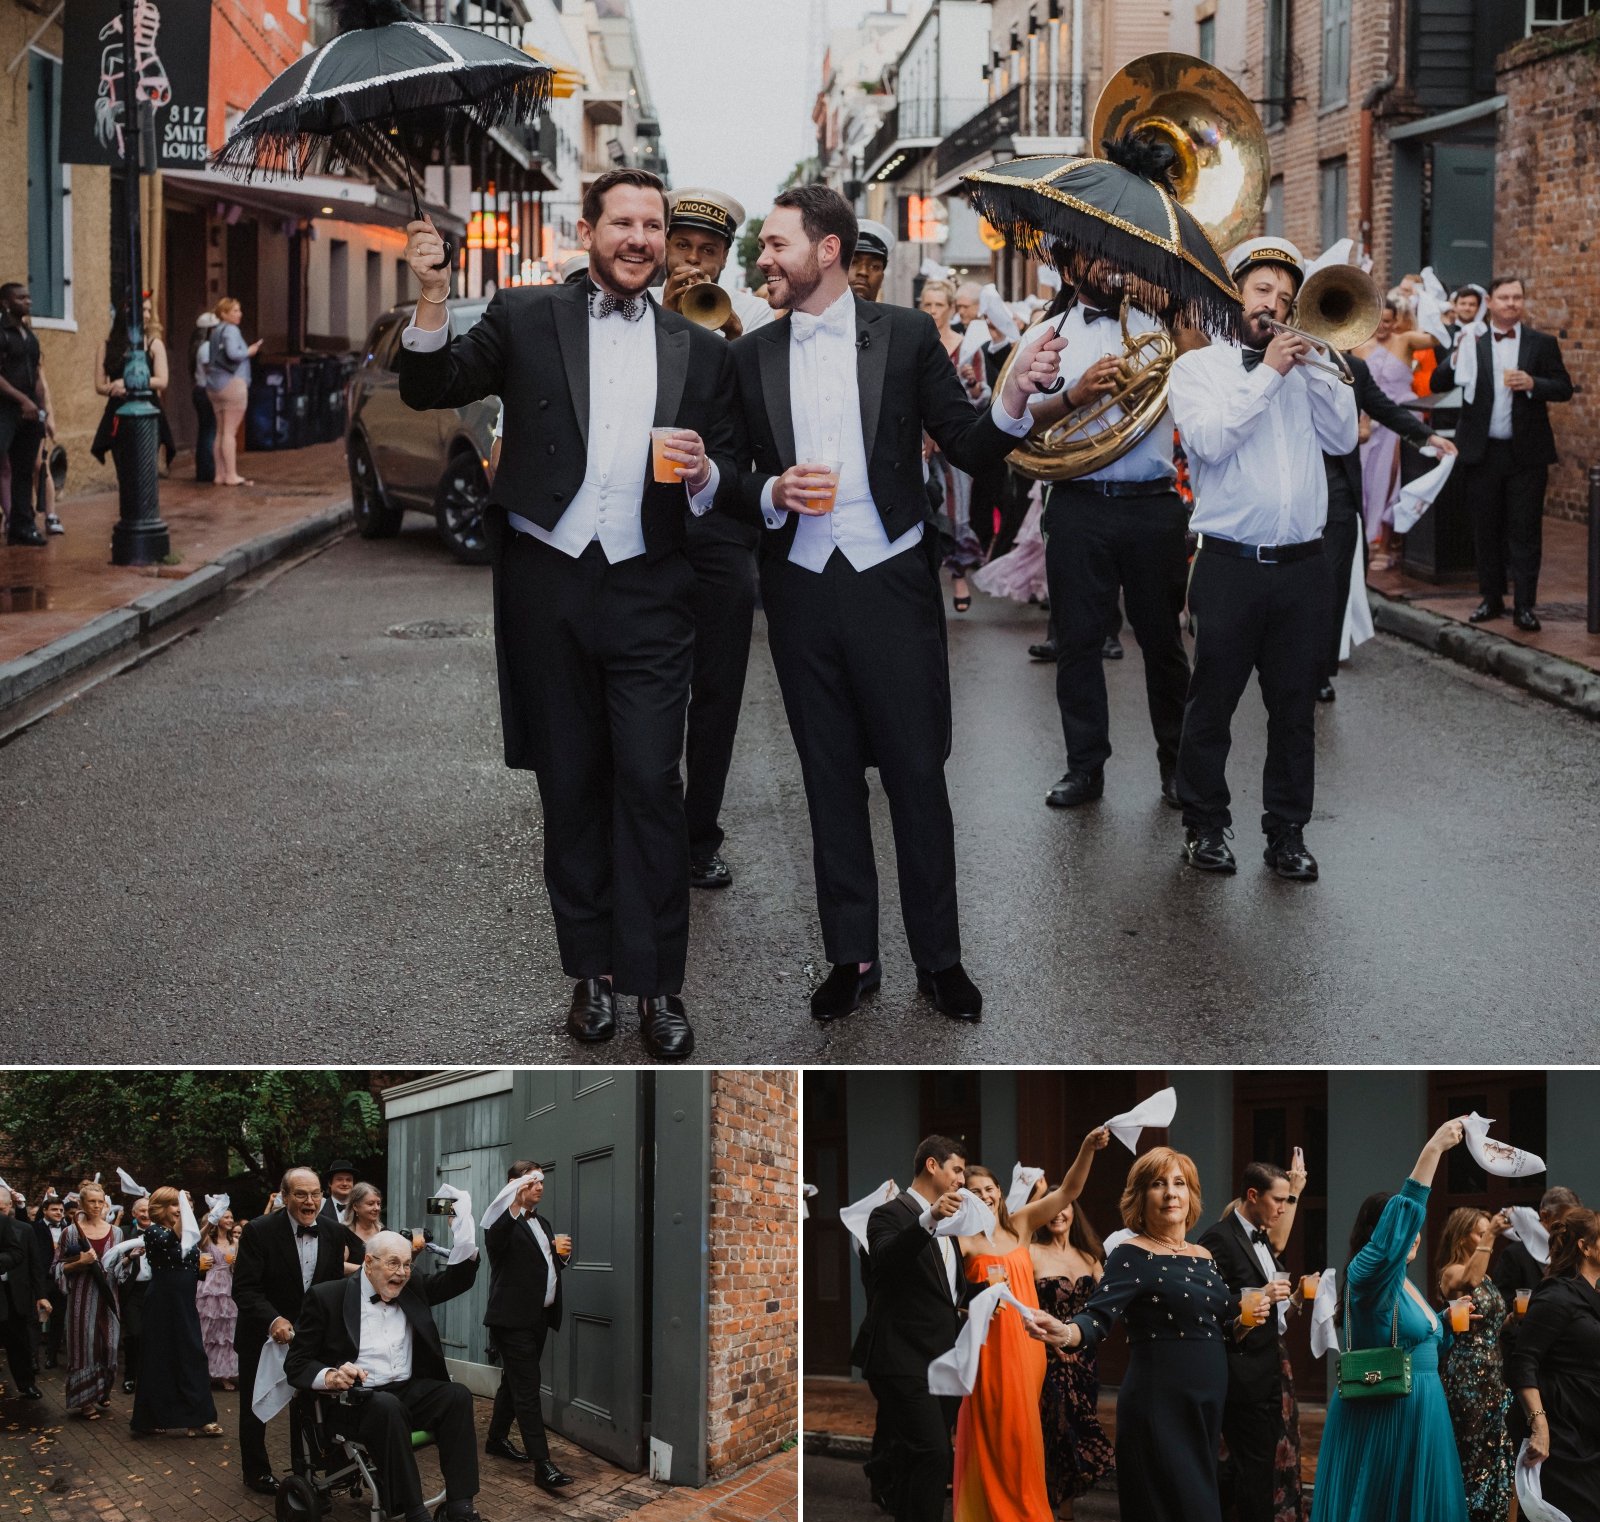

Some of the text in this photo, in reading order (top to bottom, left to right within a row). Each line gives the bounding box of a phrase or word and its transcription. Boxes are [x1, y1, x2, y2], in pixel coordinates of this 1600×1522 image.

[169, 104, 206, 124] 817
[164, 123, 206, 142] SAINT
[162, 142, 206, 161] LOUIS
[679, 202, 725, 221] KNOCKAZ
